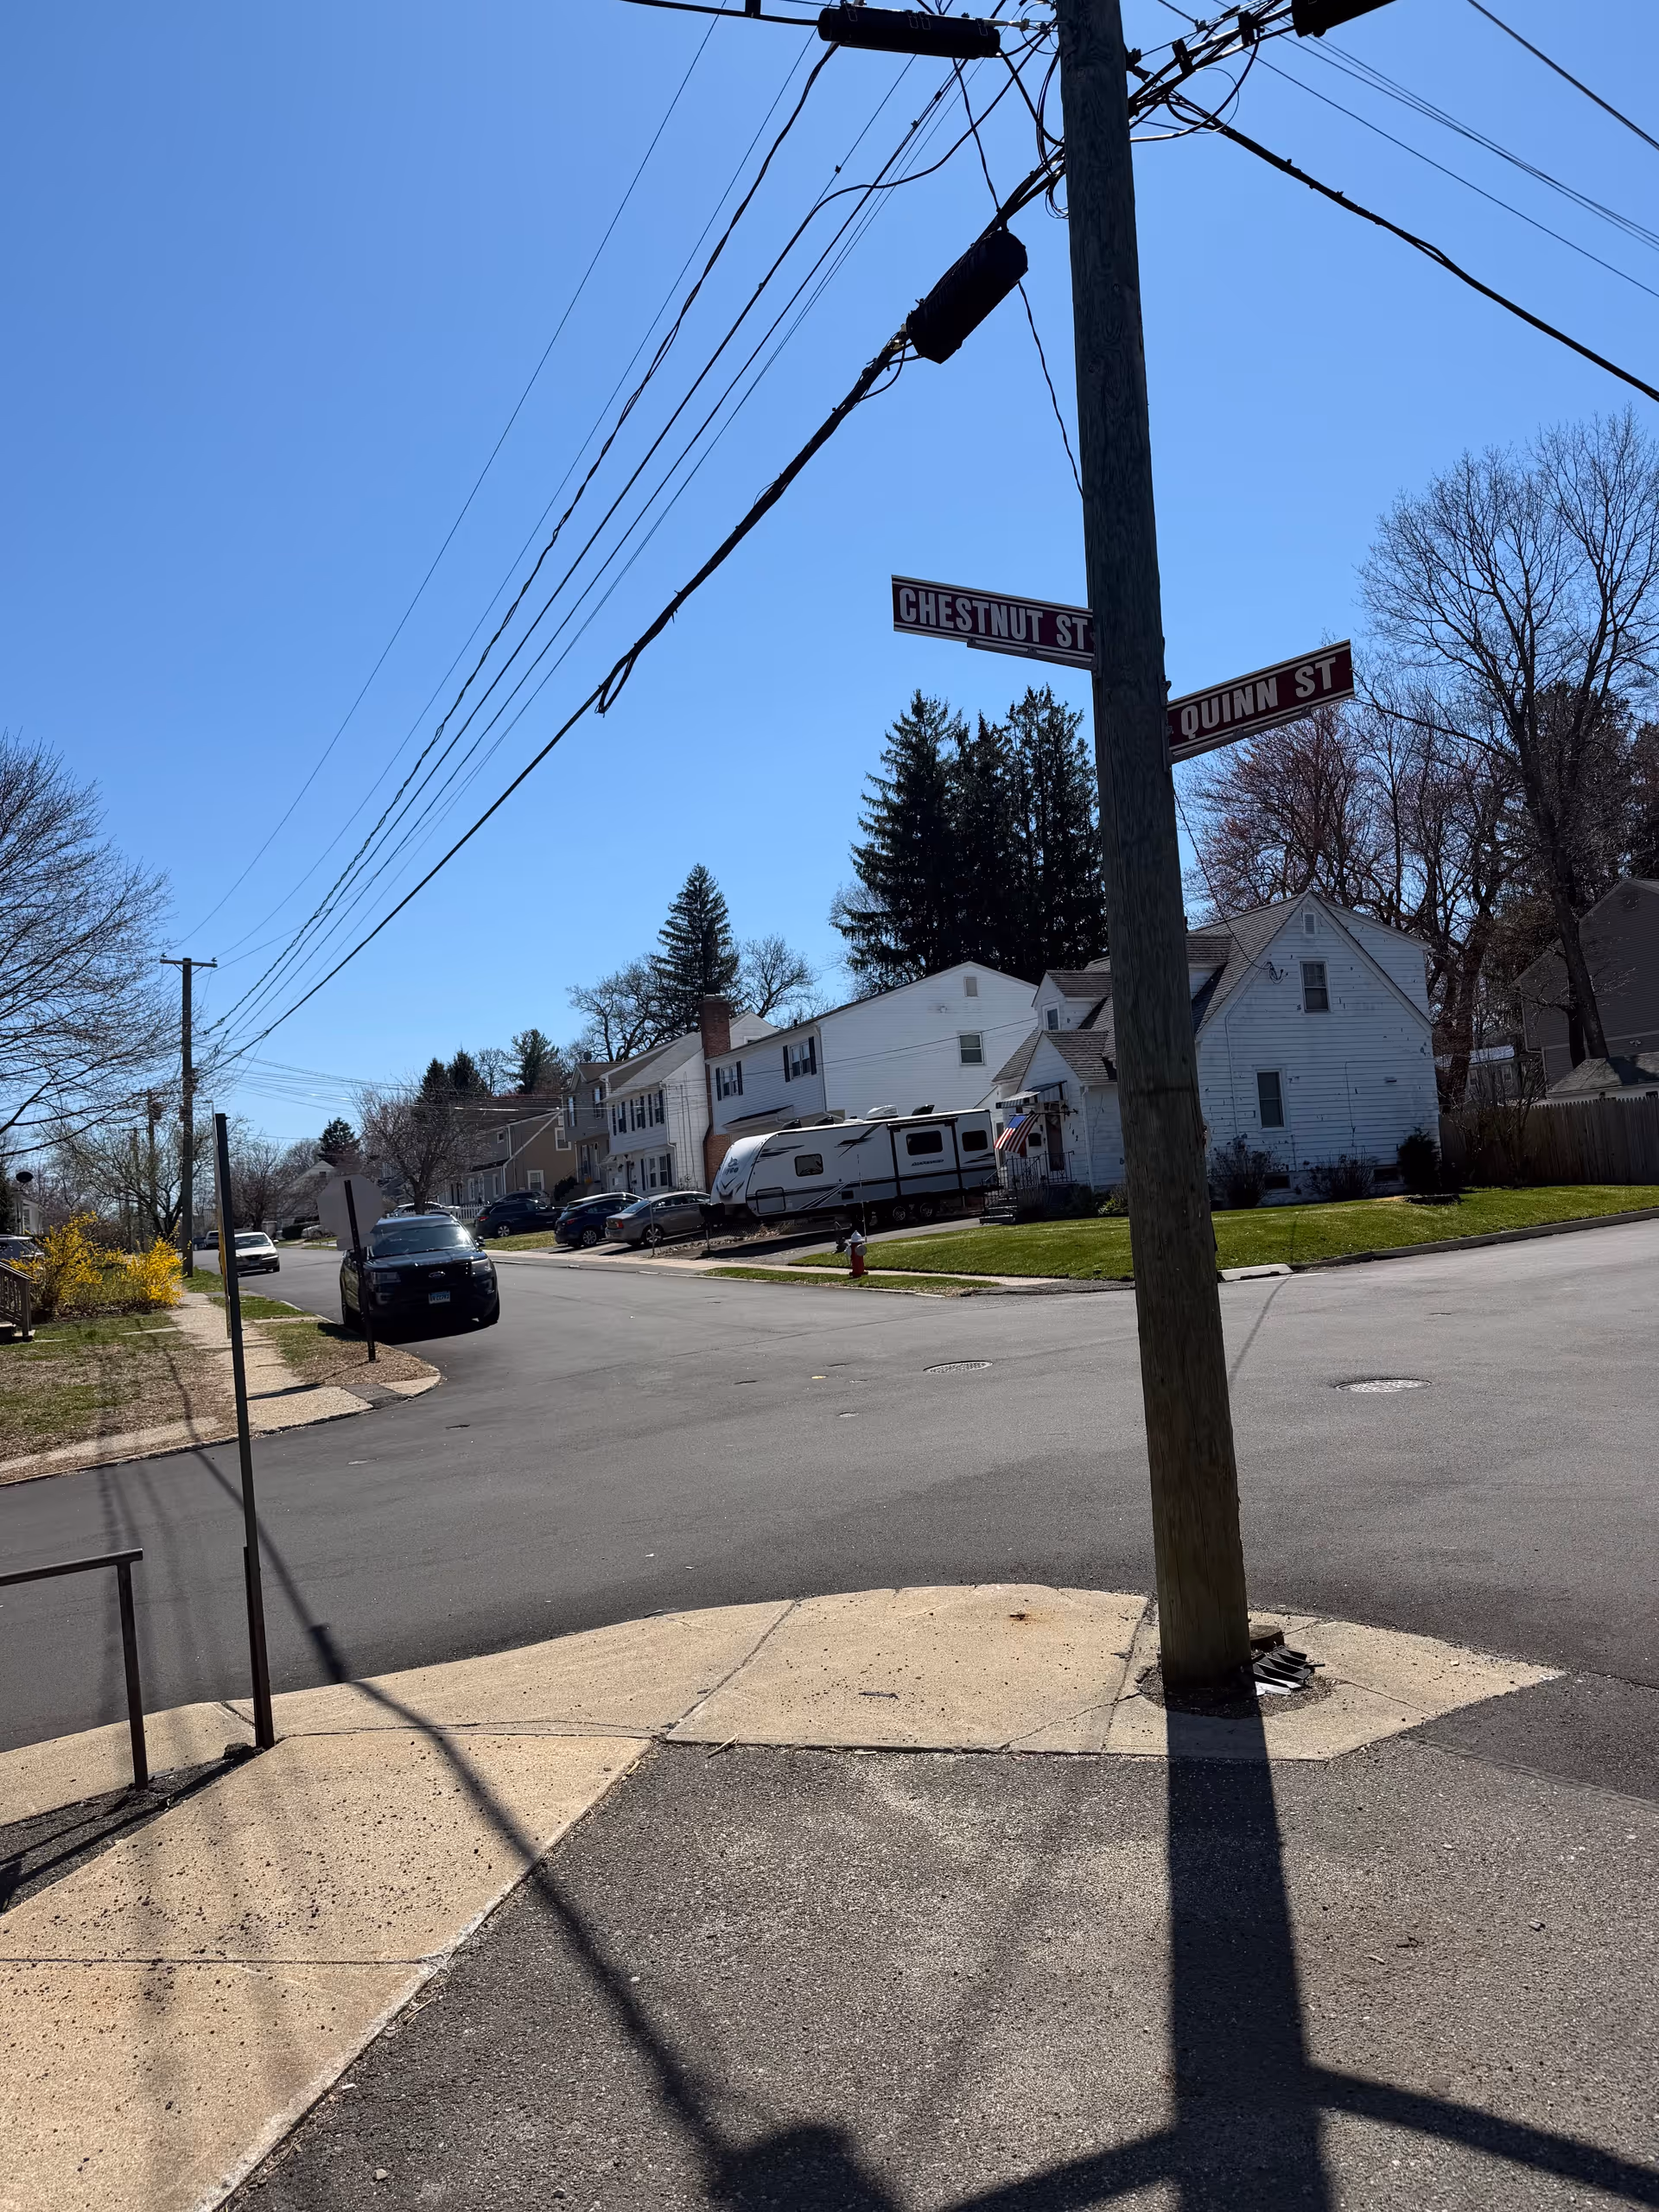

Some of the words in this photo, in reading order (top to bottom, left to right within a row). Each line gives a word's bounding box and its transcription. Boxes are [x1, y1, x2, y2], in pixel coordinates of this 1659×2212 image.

[899, 588, 1043, 643] CHESTNUT
[1056, 614, 1088, 650] ST
[1180, 677, 1279, 740] QUINN
[1294, 657, 1336, 698] ST
